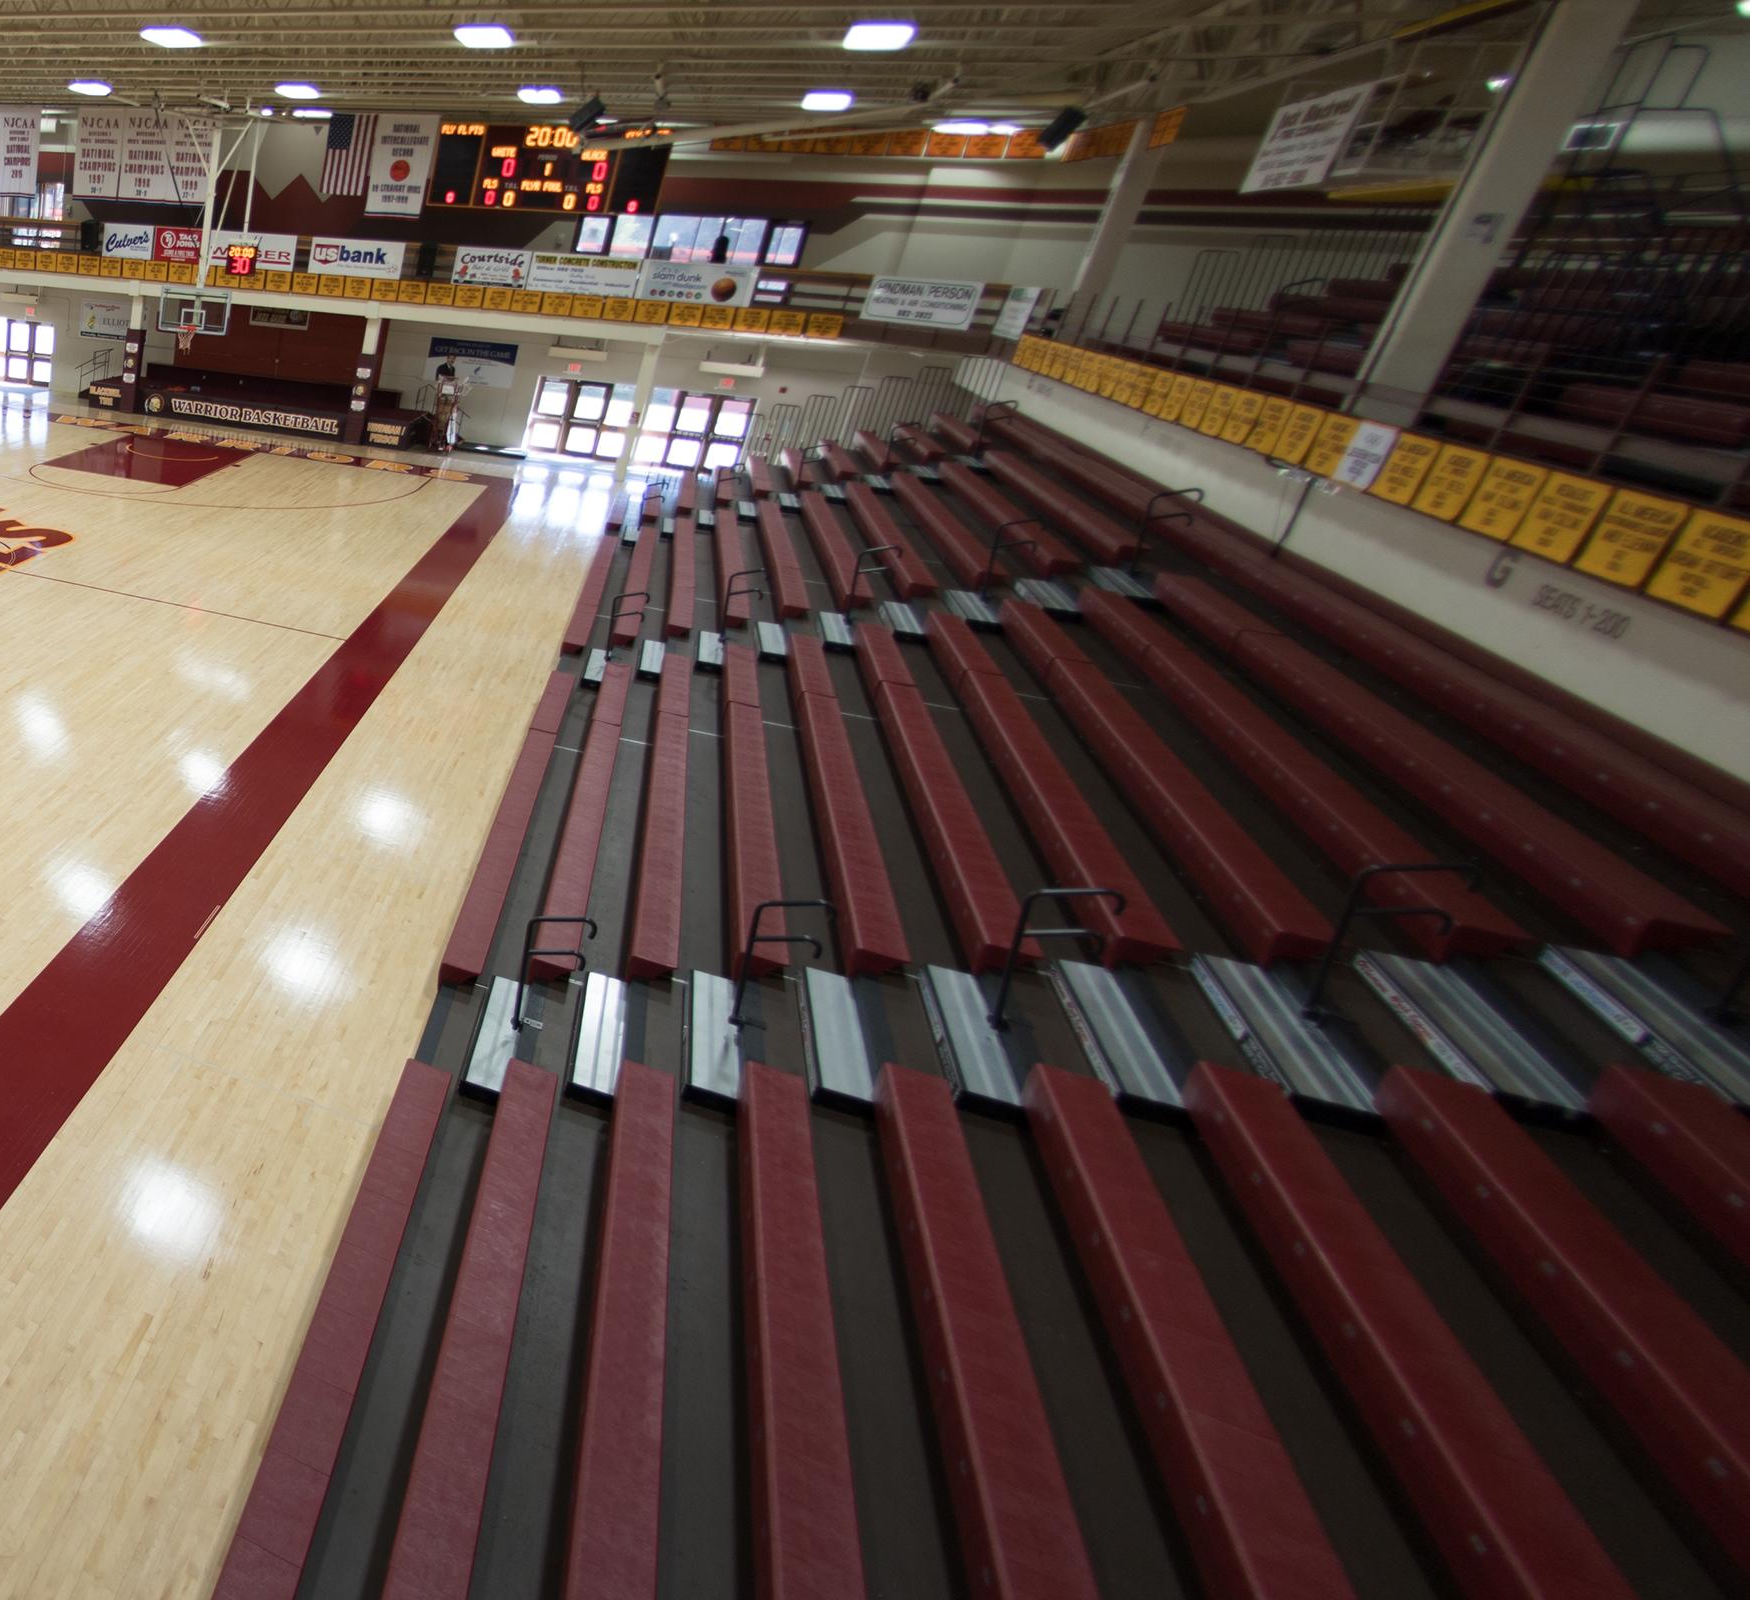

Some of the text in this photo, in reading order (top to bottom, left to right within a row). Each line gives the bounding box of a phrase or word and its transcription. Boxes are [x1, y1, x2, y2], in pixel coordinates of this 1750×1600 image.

[3, 117, 35, 129] NJCAA
[81, 117, 119, 129] NJCAA
[129, 117, 168, 129] NJCAA
[526, 127, 579, 148] 20:00
[82, 148, 114, 159] NATIONAL
[128, 150, 162, 161] NATIONAL
[175, 152, 209, 163] NATIONAL
[392, 148, 413, 157] RECORD
[4, 157, 31, 166] CHAMPIONS
[79, 161, 116, 172] CHAMPIONS
[501, 158, 516, 177] 0
[124, 163, 165, 175] CHAMPIONS
[172, 166, 207, 177] CHAMPION
[544, 162, 553, 177] 1
[592, 162, 607, 181] 0
[88, 174, 105, 184] 1997
[134, 178, 150, 187] 1998
[181, 180, 198, 190] 1999
[105, 230, 150, 253] Culver's
[179, 233, 198, 242] TACO
[228, 246, 255, 258] 20:00
[231, 257, 251, 274] 30
[460, 252, 525, 268] Courtside
[559, 257, 590, 267] CONCRETE
[592, 259, 638, 269] CONSTRUCTION
[651, 271, 703, 282] slam dunk
[928, 286, 973, 300] PERSON
[170, 397, 339, 436] WARRIOR BASKETBALL
[1485, 548, 1521, 589] G
[1533, 582, 1632, 641] SEATS 1-200
